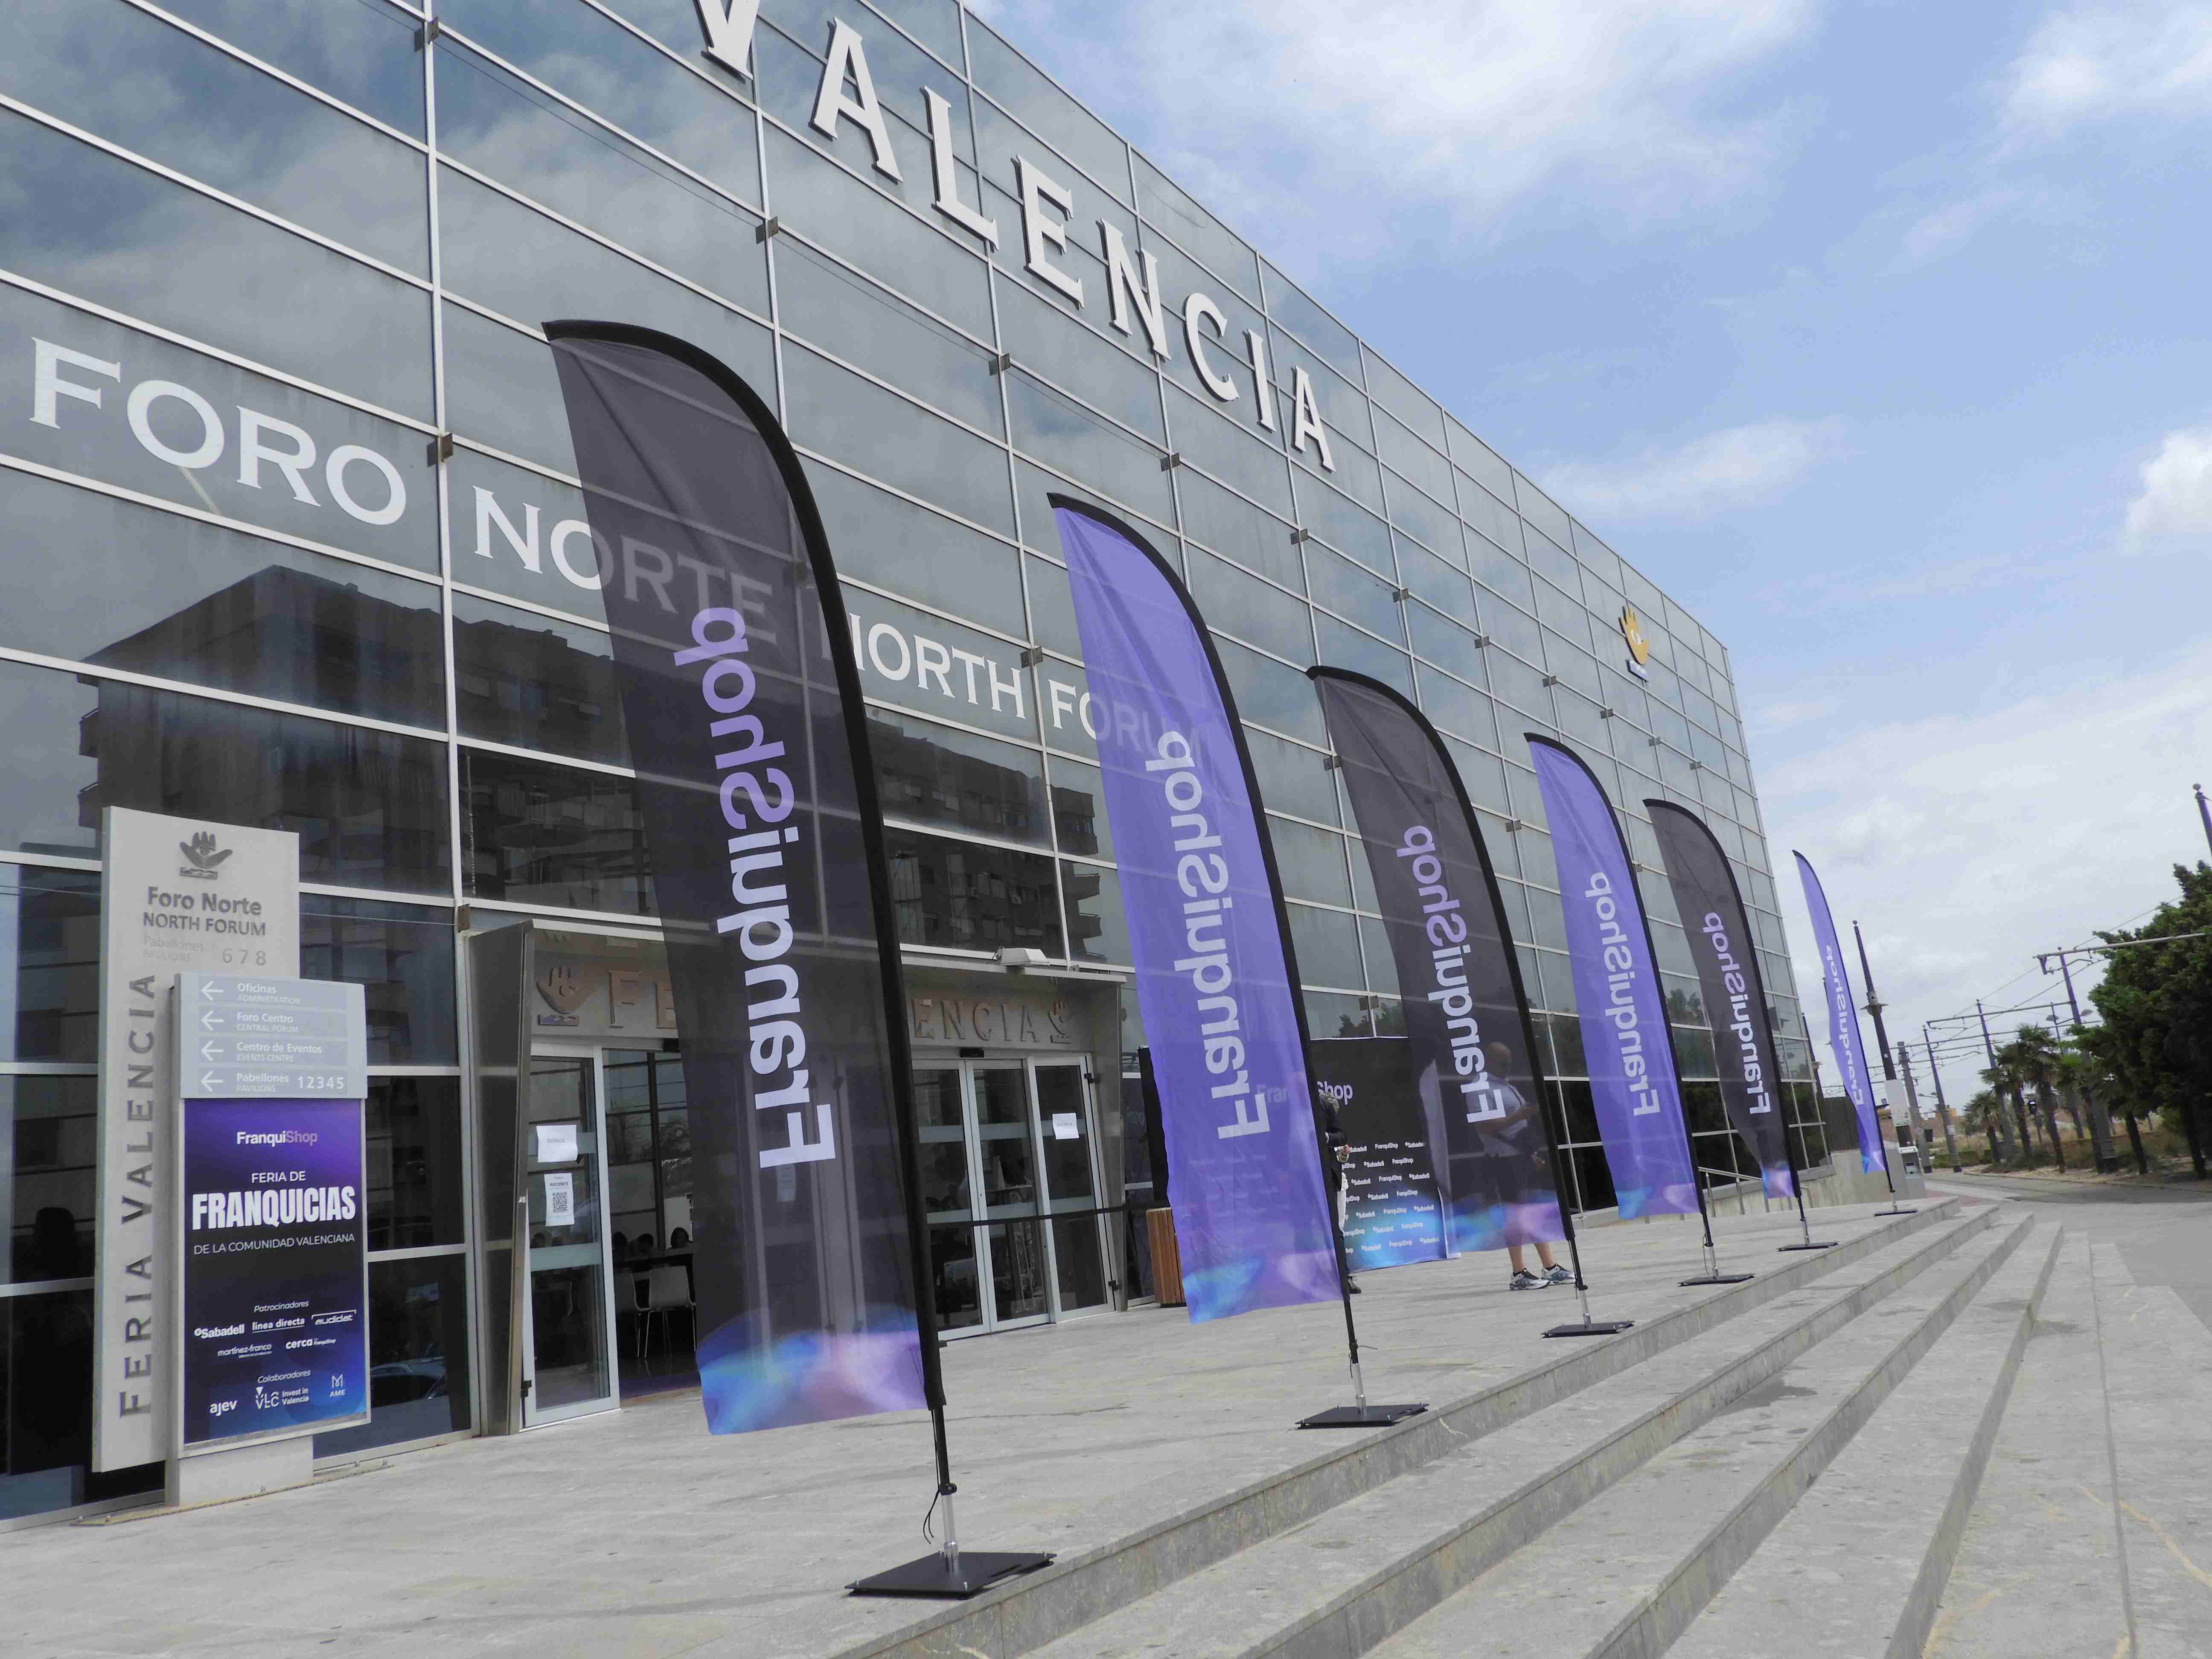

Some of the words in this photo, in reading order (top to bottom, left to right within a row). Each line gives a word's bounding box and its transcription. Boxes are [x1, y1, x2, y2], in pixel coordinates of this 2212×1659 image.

[29, 336, 407, 525] FORO
[472, 485, 777, 646] NORTE
[147, 886, 195, 910] Foro
[202, 893, 262, 915] Norte
[143, 911, 199, 931] NORTH
[205, 917, 266, 936] FORUM
[237, 982, 277, 994] Oficinas
[237, 1013, 259, 1022] Foro
[262, 1013, 293, 1023] Centro
[910, 997, 1039, 1042] ENCIA
[236, 1042, 270, 1052] Centro
[273, 1042, 284, 1052] de
[287, 1044, 323, 1054] Eventos
[236, 1073, 290, 1083] Pabellones
[121, 974, 156, 1225] VALENCIA
[236, 1131, 318, 1147] FranquiShop
[251, 1172, 287, 1184] FERIA
[289, 1170, 306, 1182] DE
[192, 1185, 356, 1231] FRANQUICIAS
[1343, 1228, 1365, 1237] ranquiShop
[194, 1243, 210, 1255] DE
[213, 1242, 227, 1253] LA
[228, 1237, 295, 1252] COMUNIDAD
[296, 1233, 355, 1246] VALENCIANA
[253, 1301, 309, 1313] Patrocinadores
[201, 1324, 245, 1339] Sabadell
[275, 1317, 305, 1328] directa
[119, 1254, 153, 1418] FERIA
[285, 1338, 313, 1349] cerca
[257, 1370, 311, 1384] Colaboradores
[282, 1389, 301, 1397] Invest
[329, 1389, 346, 1397] AME
[281, 1395, 310, 1406] Valencia
[210, 1399, 237, 1417] ajev
